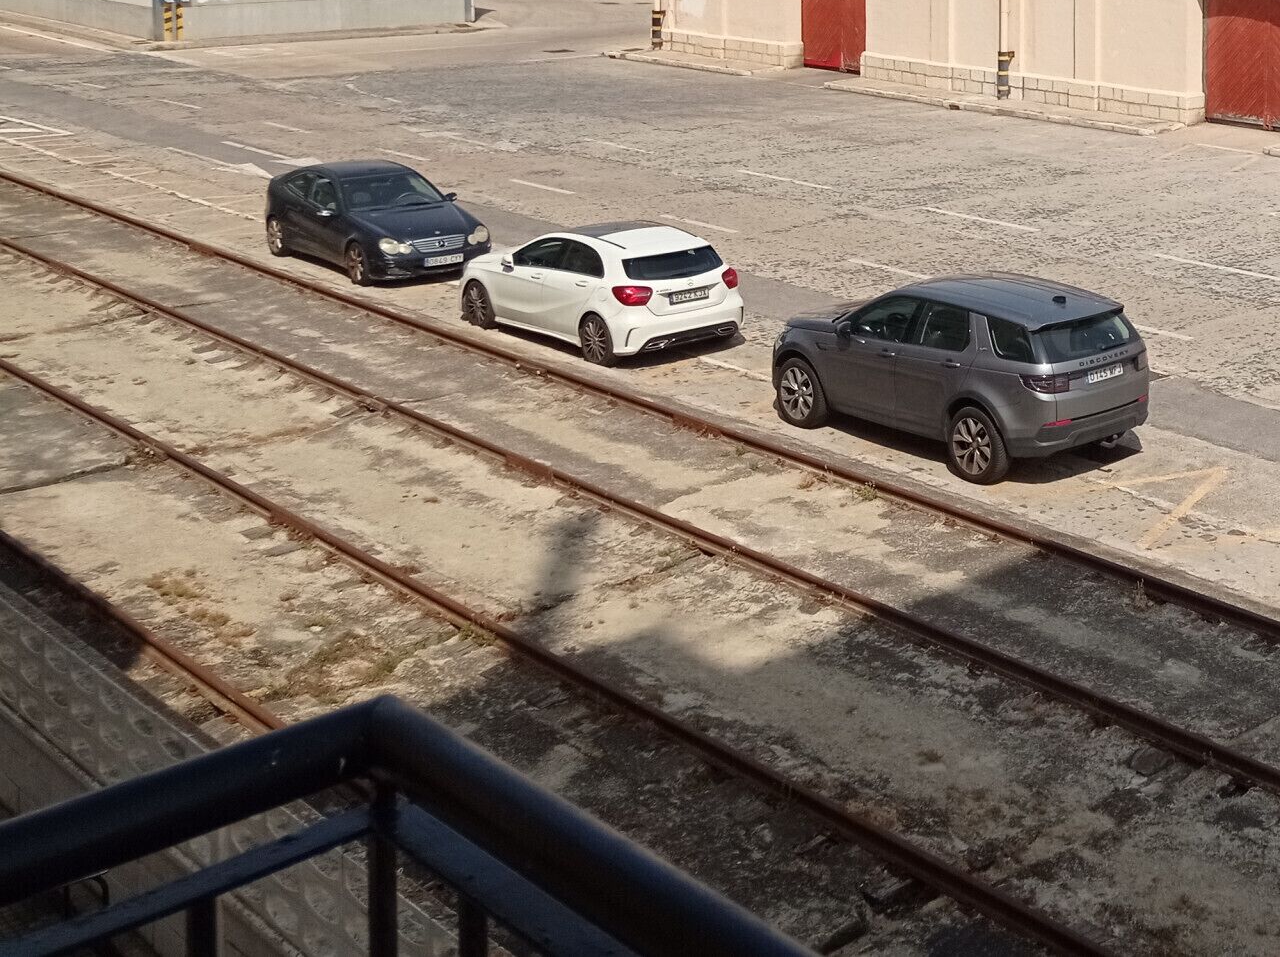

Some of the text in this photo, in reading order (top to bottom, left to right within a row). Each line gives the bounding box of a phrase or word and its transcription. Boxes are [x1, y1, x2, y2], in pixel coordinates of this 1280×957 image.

[674, 291, 692, 302] 9242
[1079, 350, 1129, 367] DISCOVERY
[1089, 368, 1108, 381] 0145
